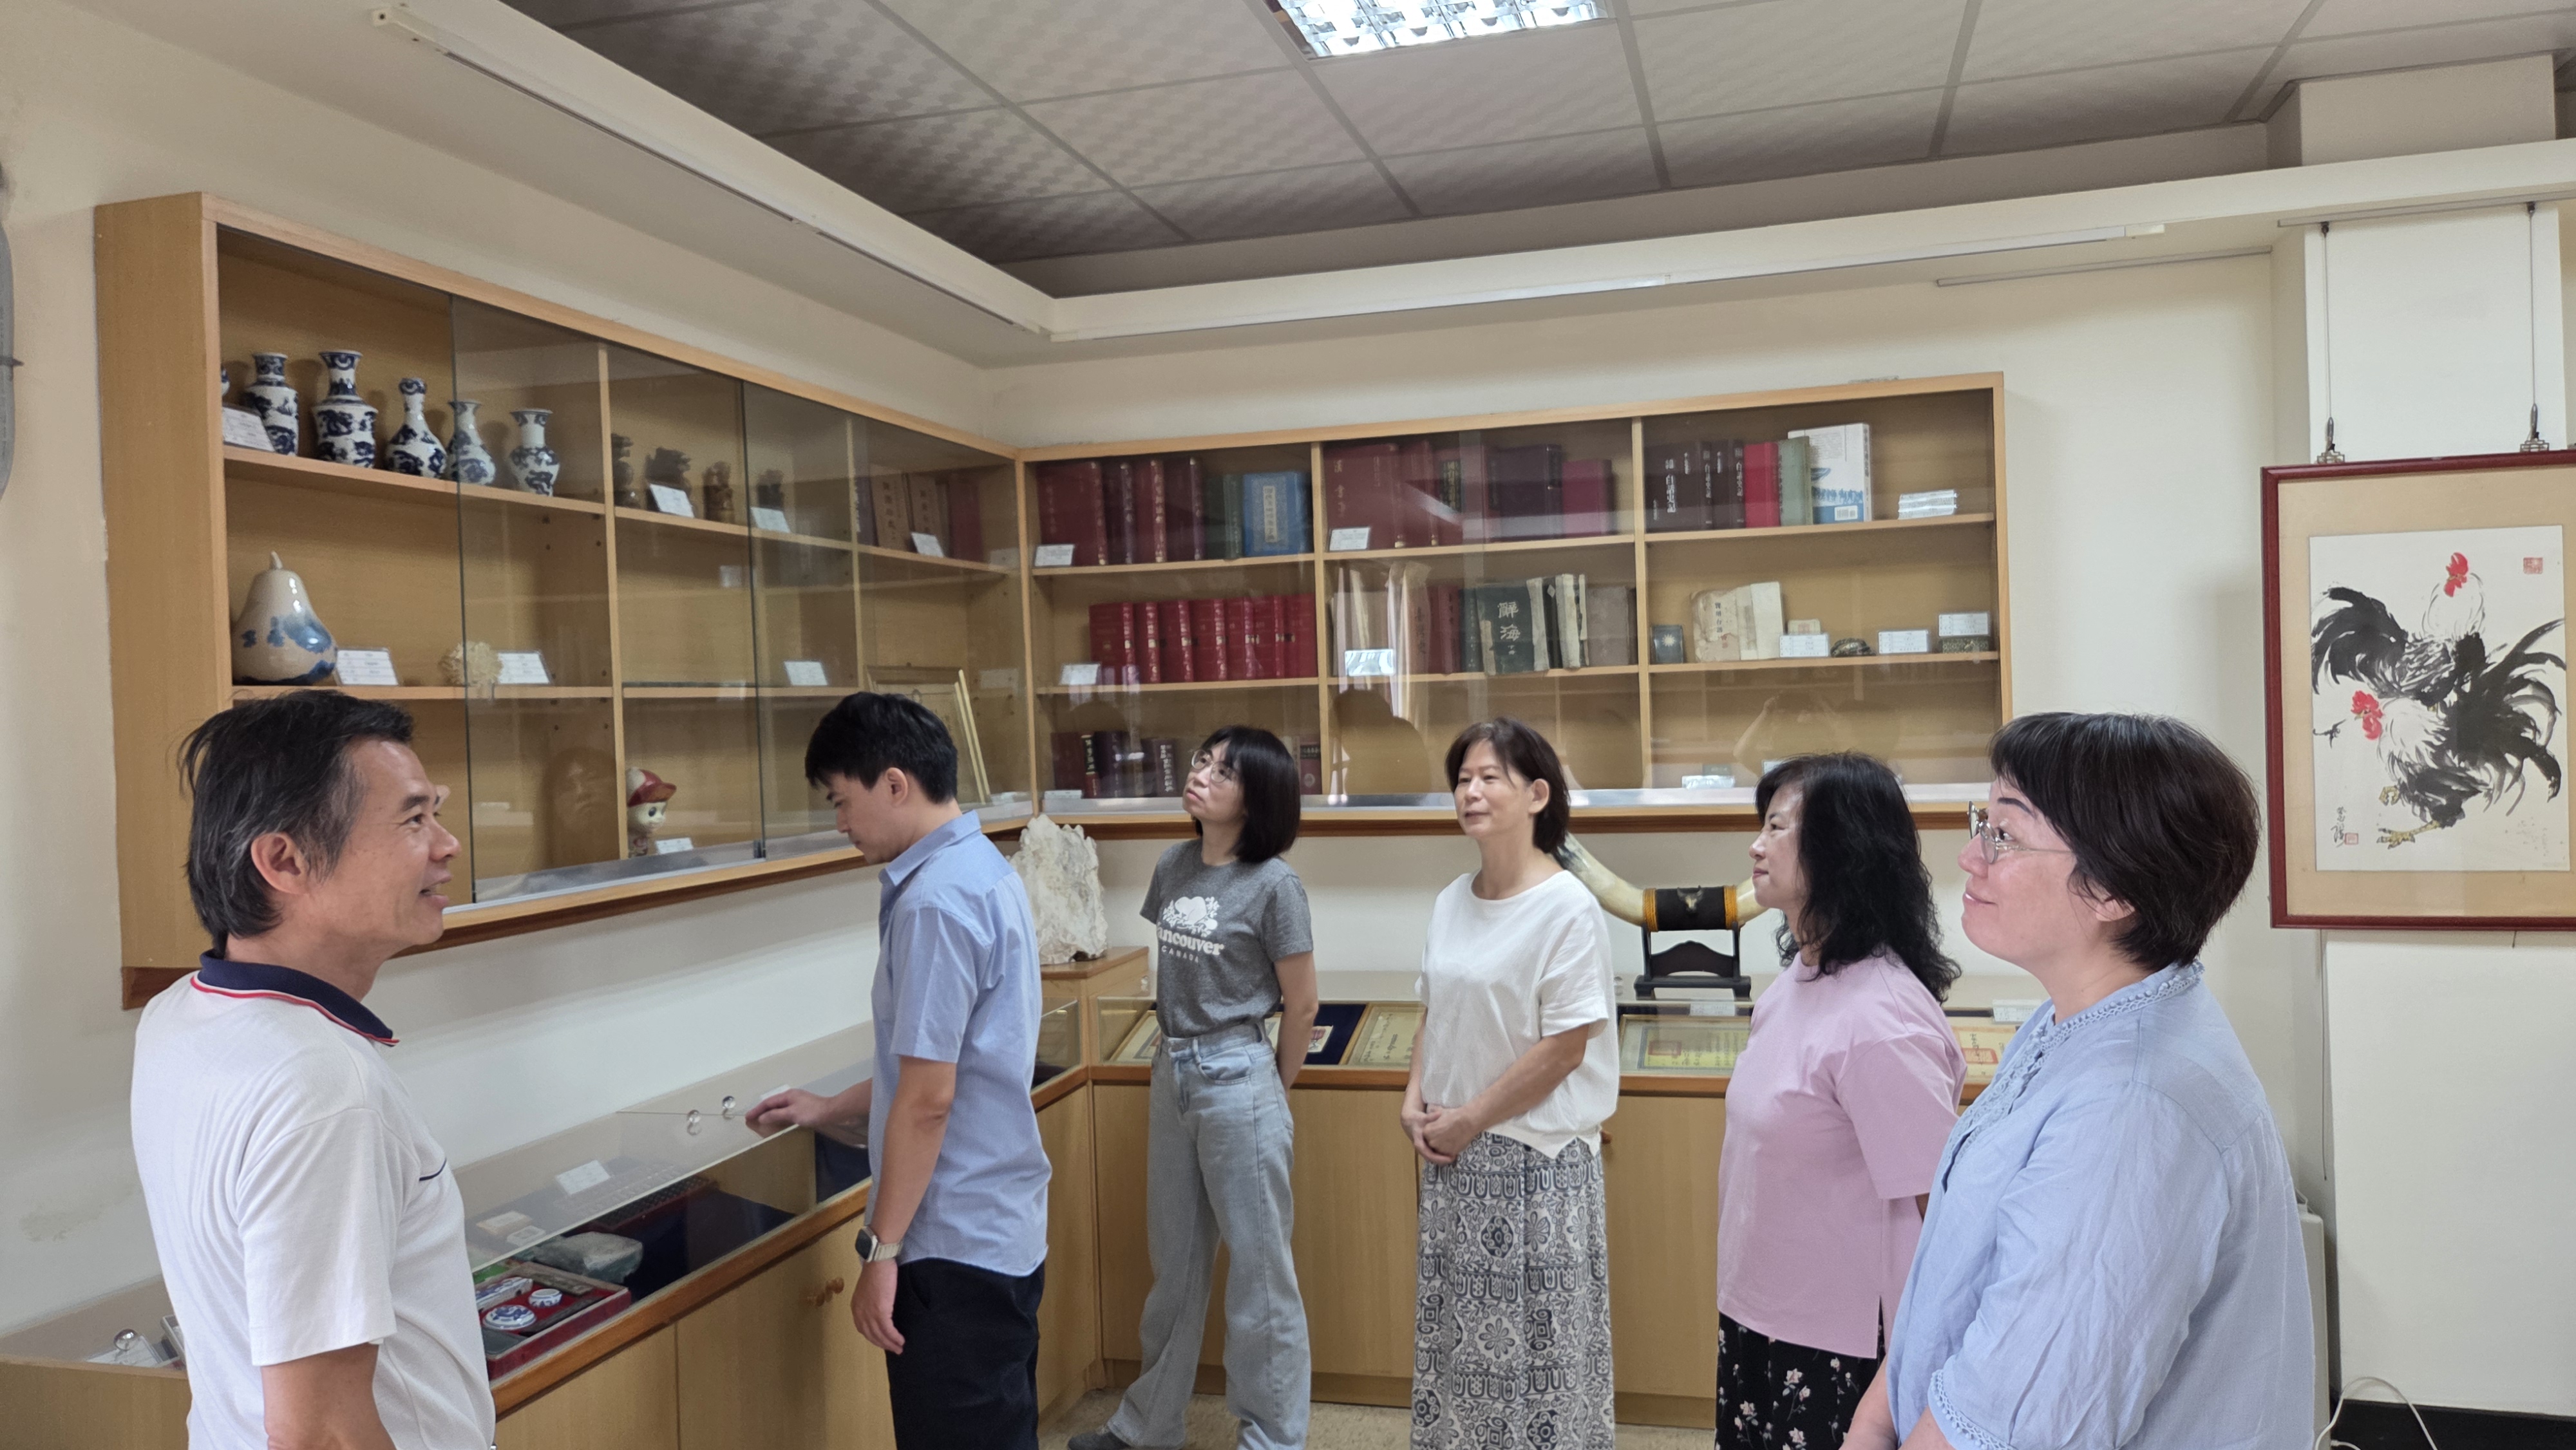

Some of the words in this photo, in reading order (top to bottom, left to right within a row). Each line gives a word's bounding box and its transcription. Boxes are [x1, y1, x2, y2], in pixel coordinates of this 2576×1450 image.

[1497, 601, 1521, 641] 辭海
[1157, 921, 1225, 956] ancouver
[1161, 945, 1200, 963] CANADA
